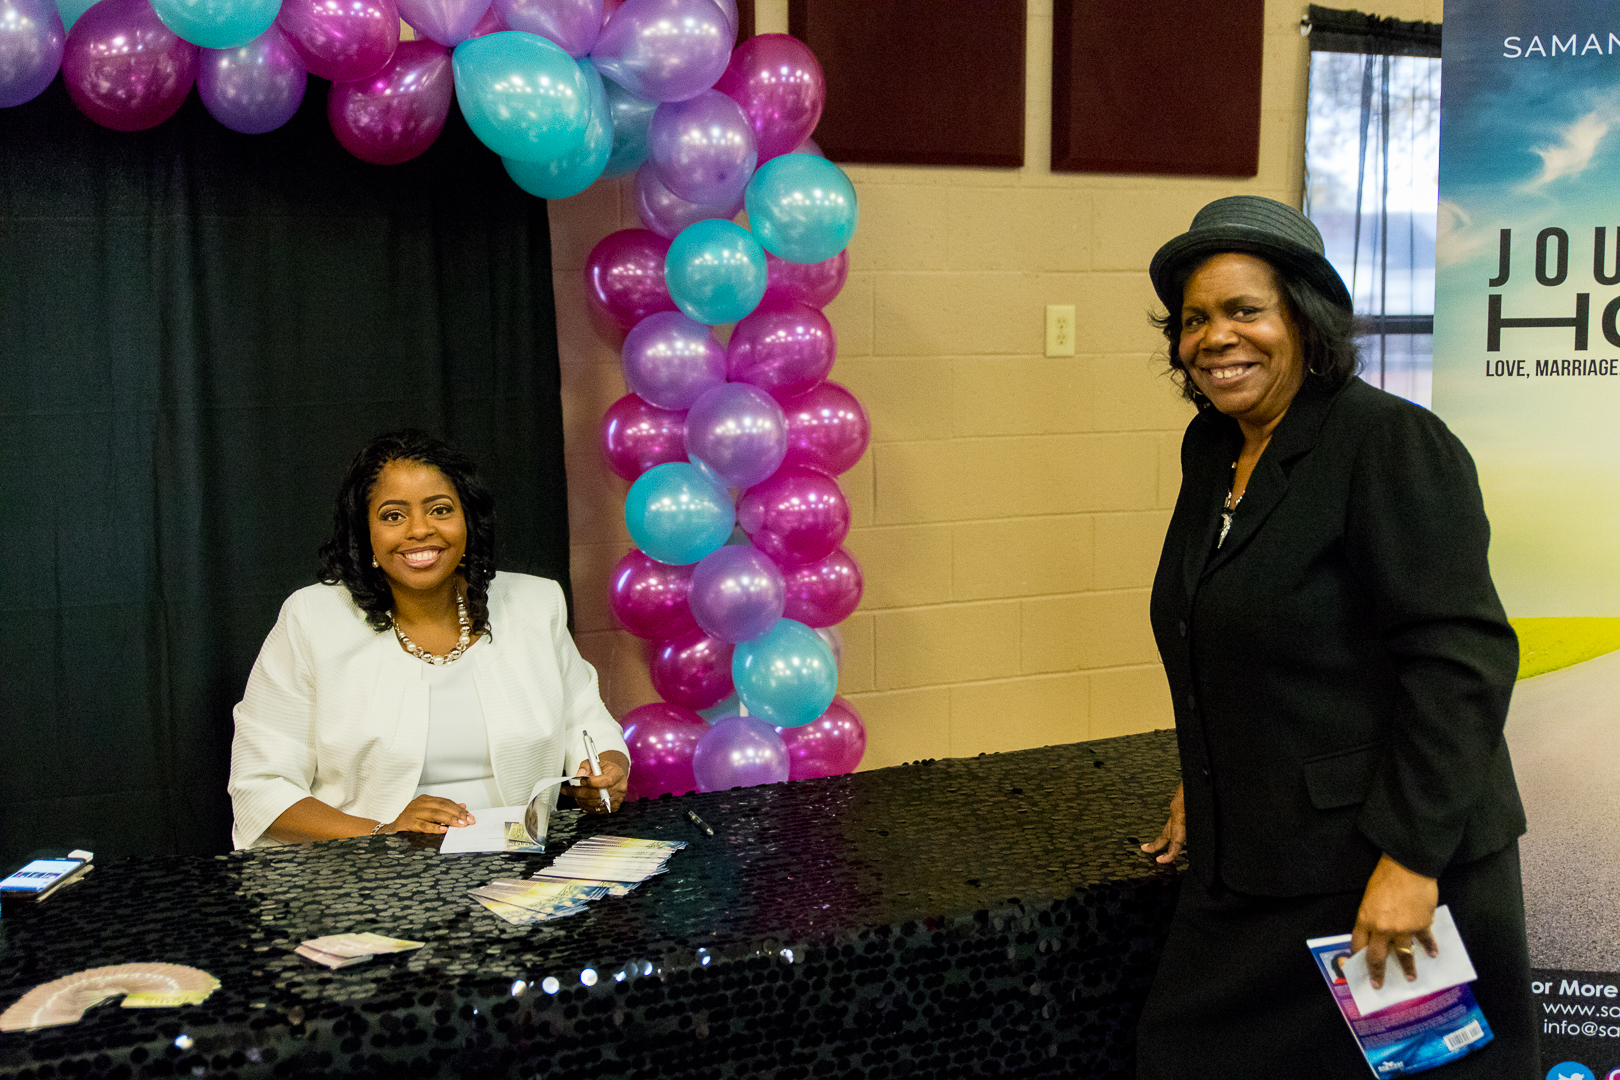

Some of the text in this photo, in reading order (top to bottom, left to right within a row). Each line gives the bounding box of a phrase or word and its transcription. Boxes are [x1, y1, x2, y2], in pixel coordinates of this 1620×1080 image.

[1488, 226, 1620, 287] JOU
[1486, 359, 1530, 379] LOVE,
[1558, 979, 1618, 998] More
[1543, 1019, 1620, 1038] info@sa
